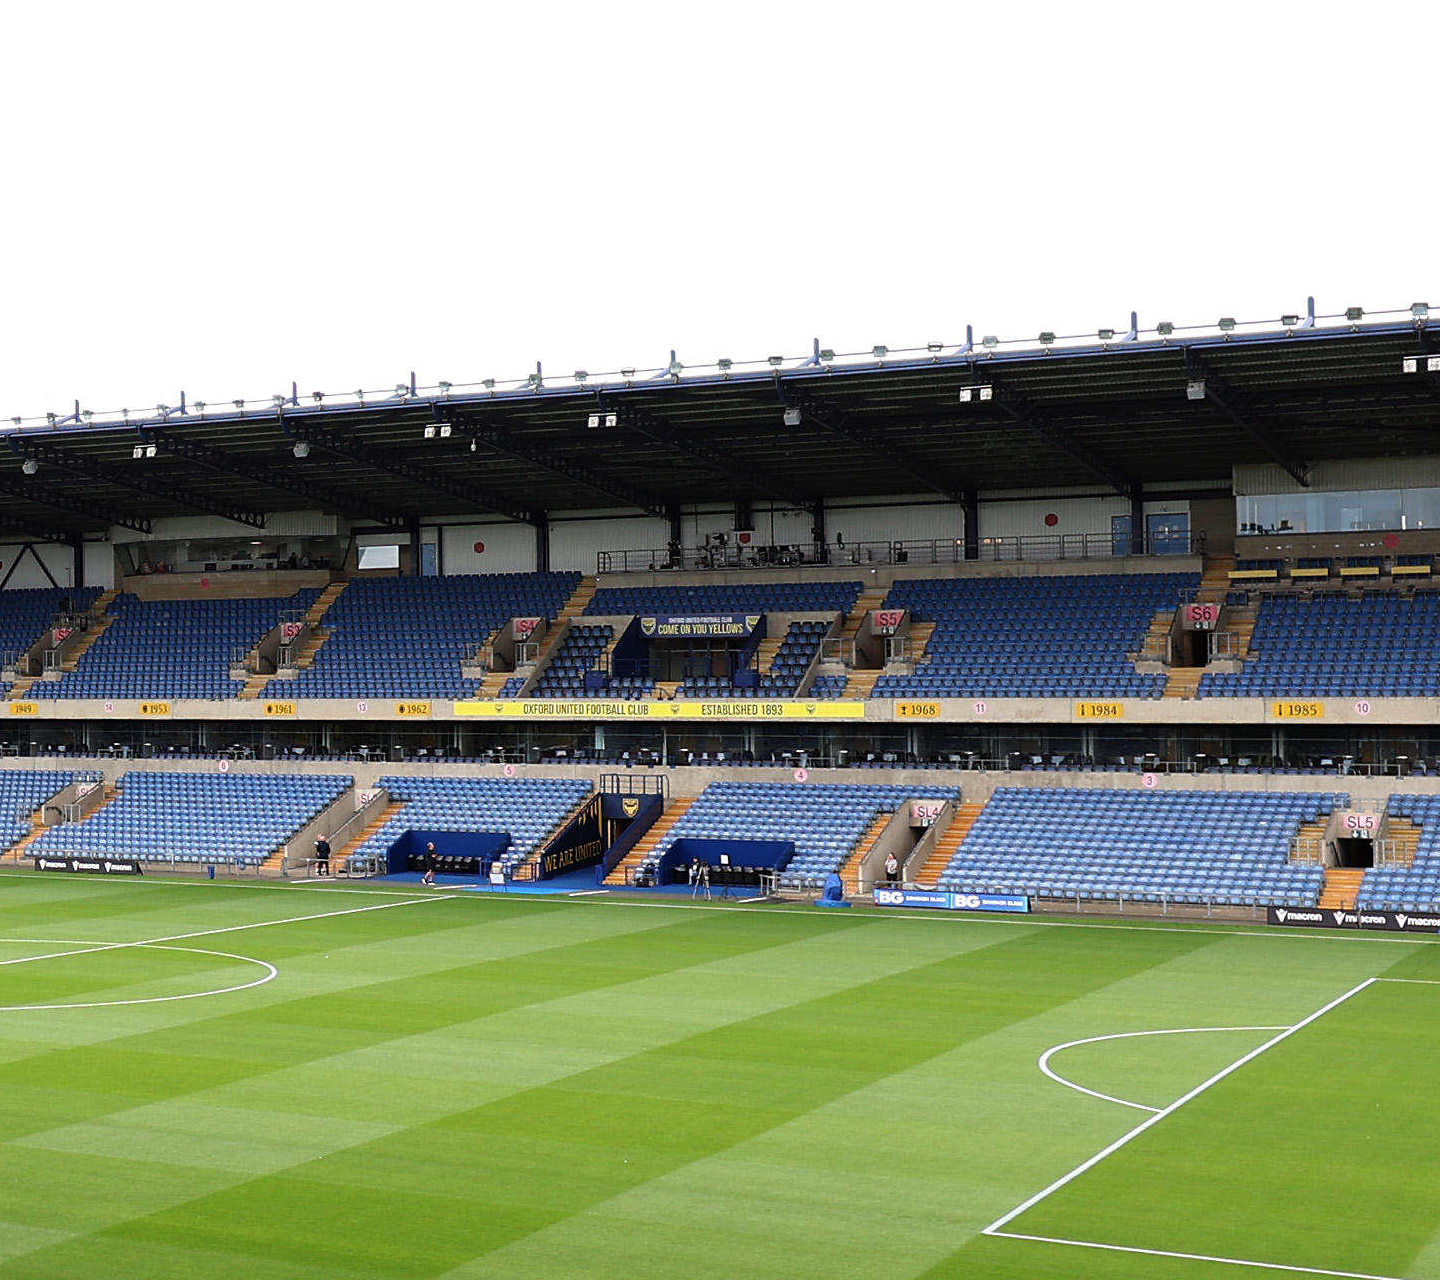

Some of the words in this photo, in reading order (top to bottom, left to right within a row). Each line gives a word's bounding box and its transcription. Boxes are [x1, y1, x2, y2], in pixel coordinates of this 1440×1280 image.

[880, 612, 897, 626] S5
[1192, 606, 1211, 620] S6
[520, 620, 534, 633] S4
[659, 624, 680, 634] COME
[681, 624, 691, 634] ON
[692, 624, 707, 634] YOU
[708, 624, 744, 634] YELLOWS
[15, 704, 32, 714] 1949
[150, 704, 168, 714] 1953
[275, 704, 292, 714] 1961
[359, 703, 366, 712] 13
[407, 704, 428, 714] 1962
[523, 703, 554, 715] OXFORD
[556, 703, 584, 715] UNITED
[586, 704, 626, 715] FOOTBALL
[628, 704, 649, 715] CLUB
[701, 704, 758, 716] ESTABLISHED
[761, 704, 783, 716] 1893
[911, 704, 936, 716] 1968
[976, 703, 985, 713] 11
[1090, 704, 1117, 716] 1984
[1288, 704, 1318, 716] 1985
[1357, 702, 1369, 714] 10
[1147, 775, 1153, 786] 3
[917, 805, 939, 818] SL4
[1347, 815, 1374, 829] SL5
[545, 853, 558, 873] WE
[559, 848, 574, 868] ARE
[575, 840, 602, 862] UNITED
[879, 891, 905, 904] BG
[955, 895, 981, 908] BG
[1287, 912, 1323, 922] macron
